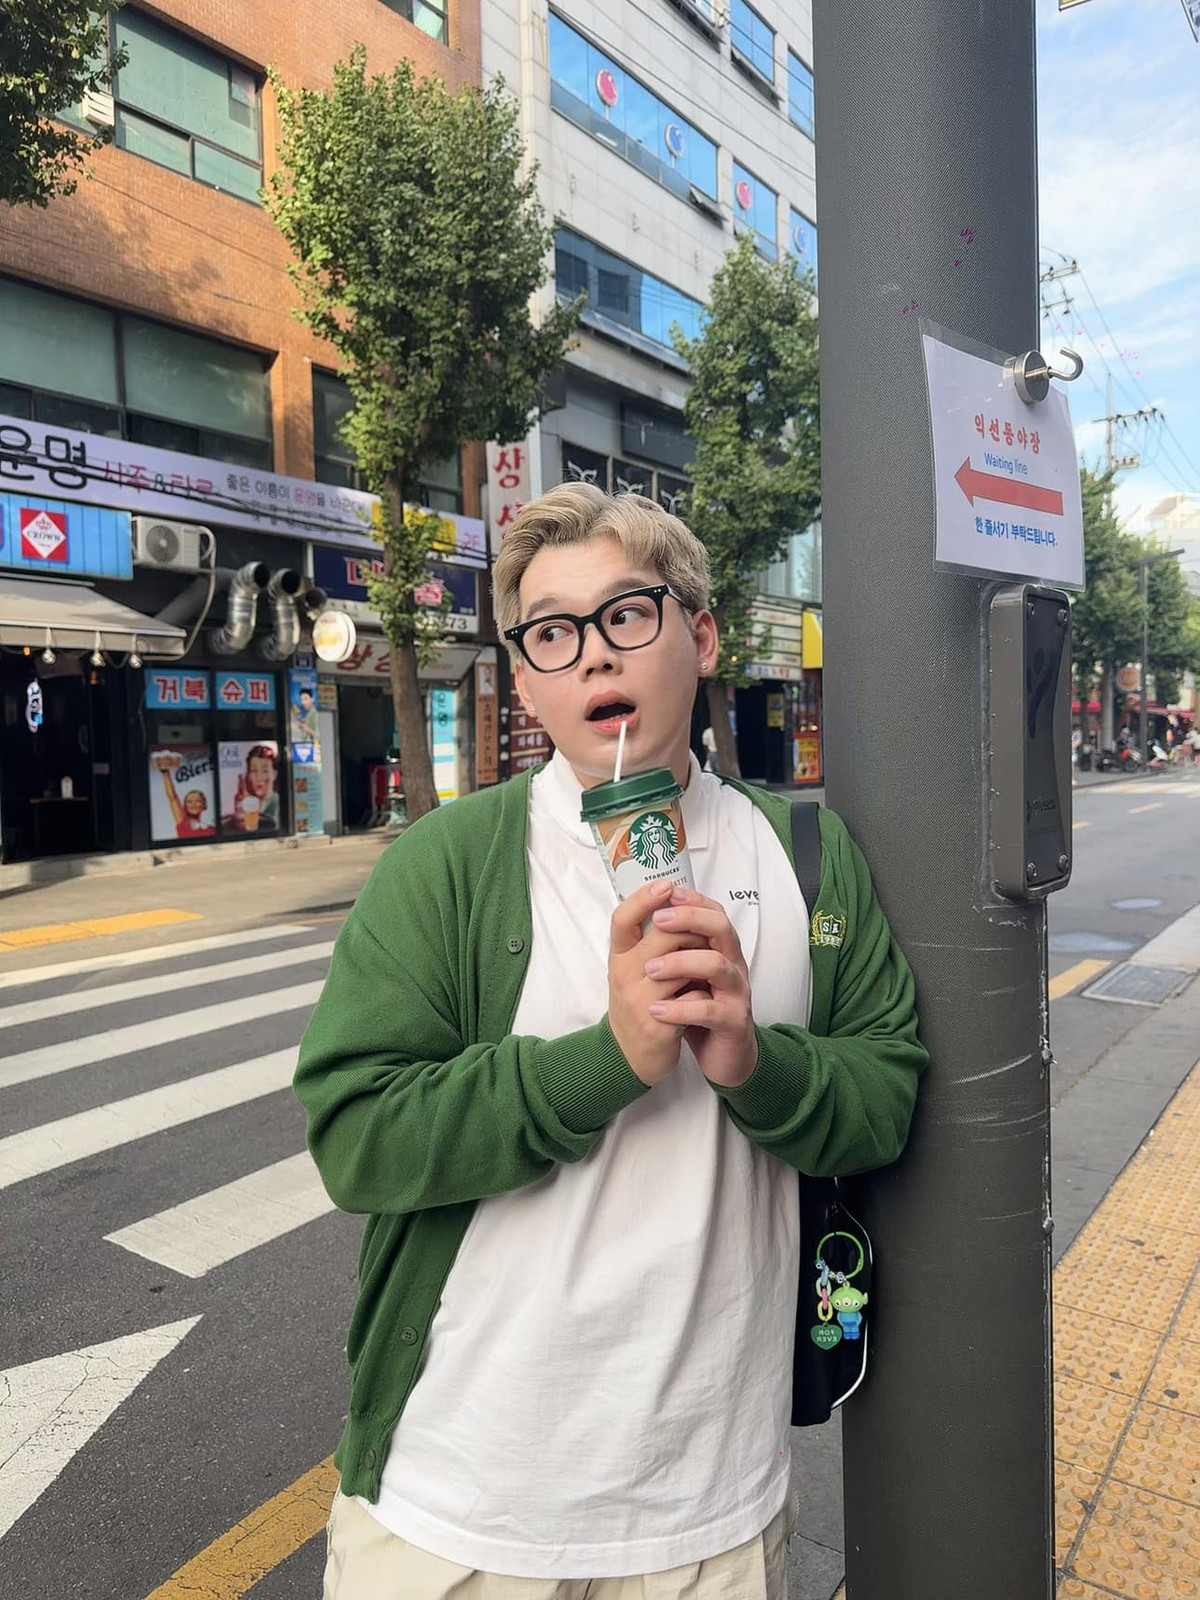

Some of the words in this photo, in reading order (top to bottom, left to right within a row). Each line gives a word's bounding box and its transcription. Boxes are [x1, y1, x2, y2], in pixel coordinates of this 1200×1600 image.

[974, 413, 1040, 454] 익선동야장
[0, 425, 88, 489] 운명
[984, 453, 1013, 474] Waiting
[1015, 459, 1028, 475] line
[975, 515, 984, 534] 한
[984, 519, 1009, 539] 줄서기
[1011, 523, 1057, 547] 부탁드립니다.
[155, 676, 207, 702] 거북
[221, 676, 271, 704] 슈퍼
[673, 875, 688, 887] ATTE
